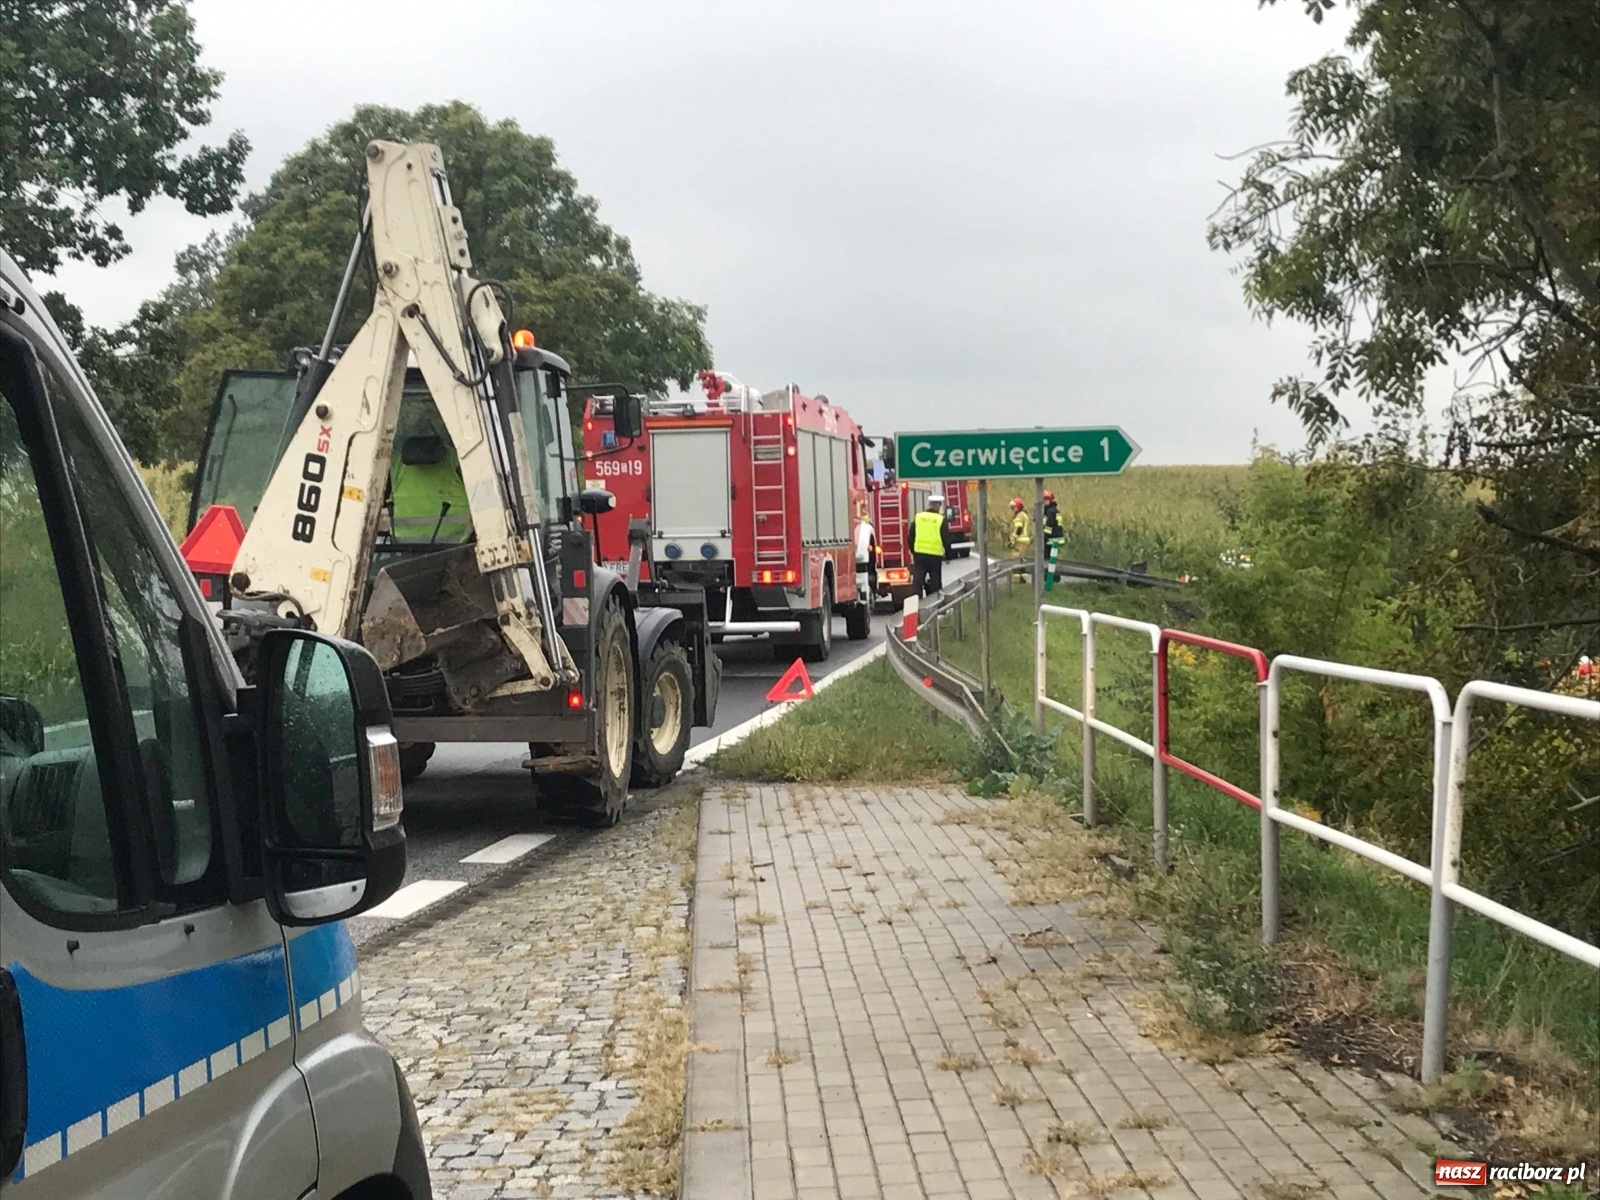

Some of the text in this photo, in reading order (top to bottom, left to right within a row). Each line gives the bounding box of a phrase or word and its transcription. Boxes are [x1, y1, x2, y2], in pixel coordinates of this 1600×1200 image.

[911, 436, 1110, 472] Czerwięcice 1
[292, 452, 327, 544] 860
